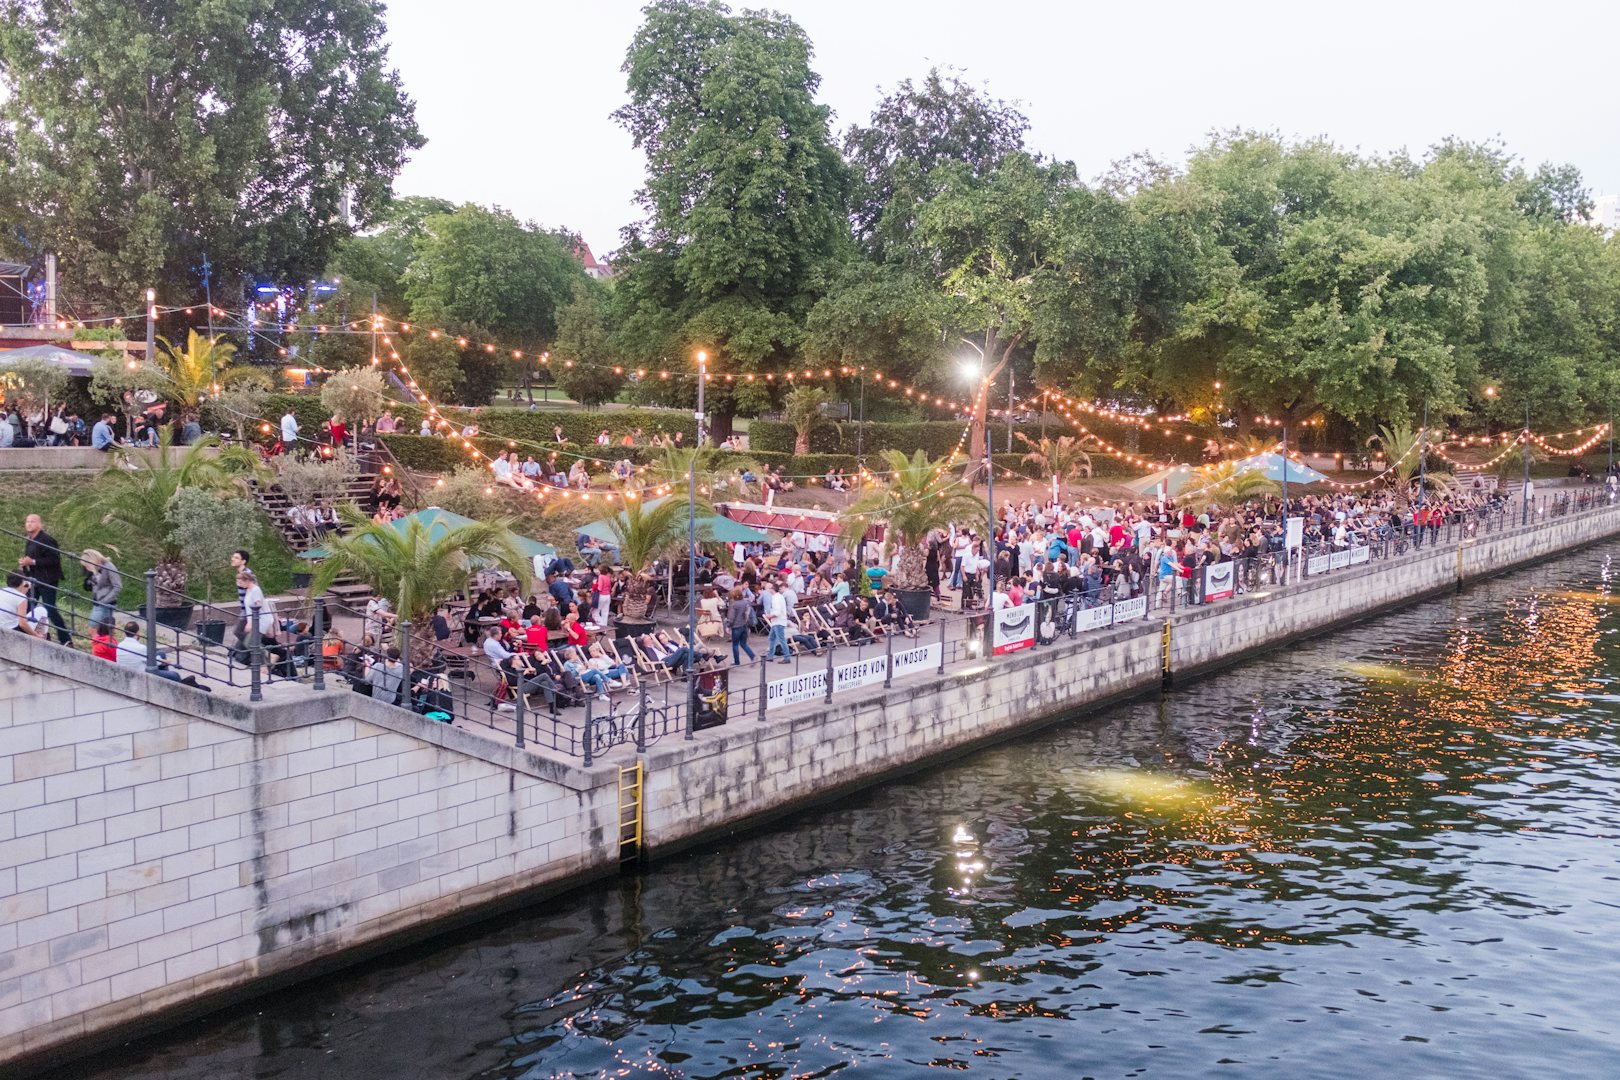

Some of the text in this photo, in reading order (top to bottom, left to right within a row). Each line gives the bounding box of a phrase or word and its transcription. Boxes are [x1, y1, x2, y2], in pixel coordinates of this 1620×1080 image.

[1093, 609, 1102, 620] DIE
[1114, 599, 1144, 614] SCHULDIGEN
[769, 683, 783, 699] DIE
[838, 663, 867, 682] WEIBER
[871, 660, 885, 674] VON
[895, 648, 928, 667] WINDSOR
